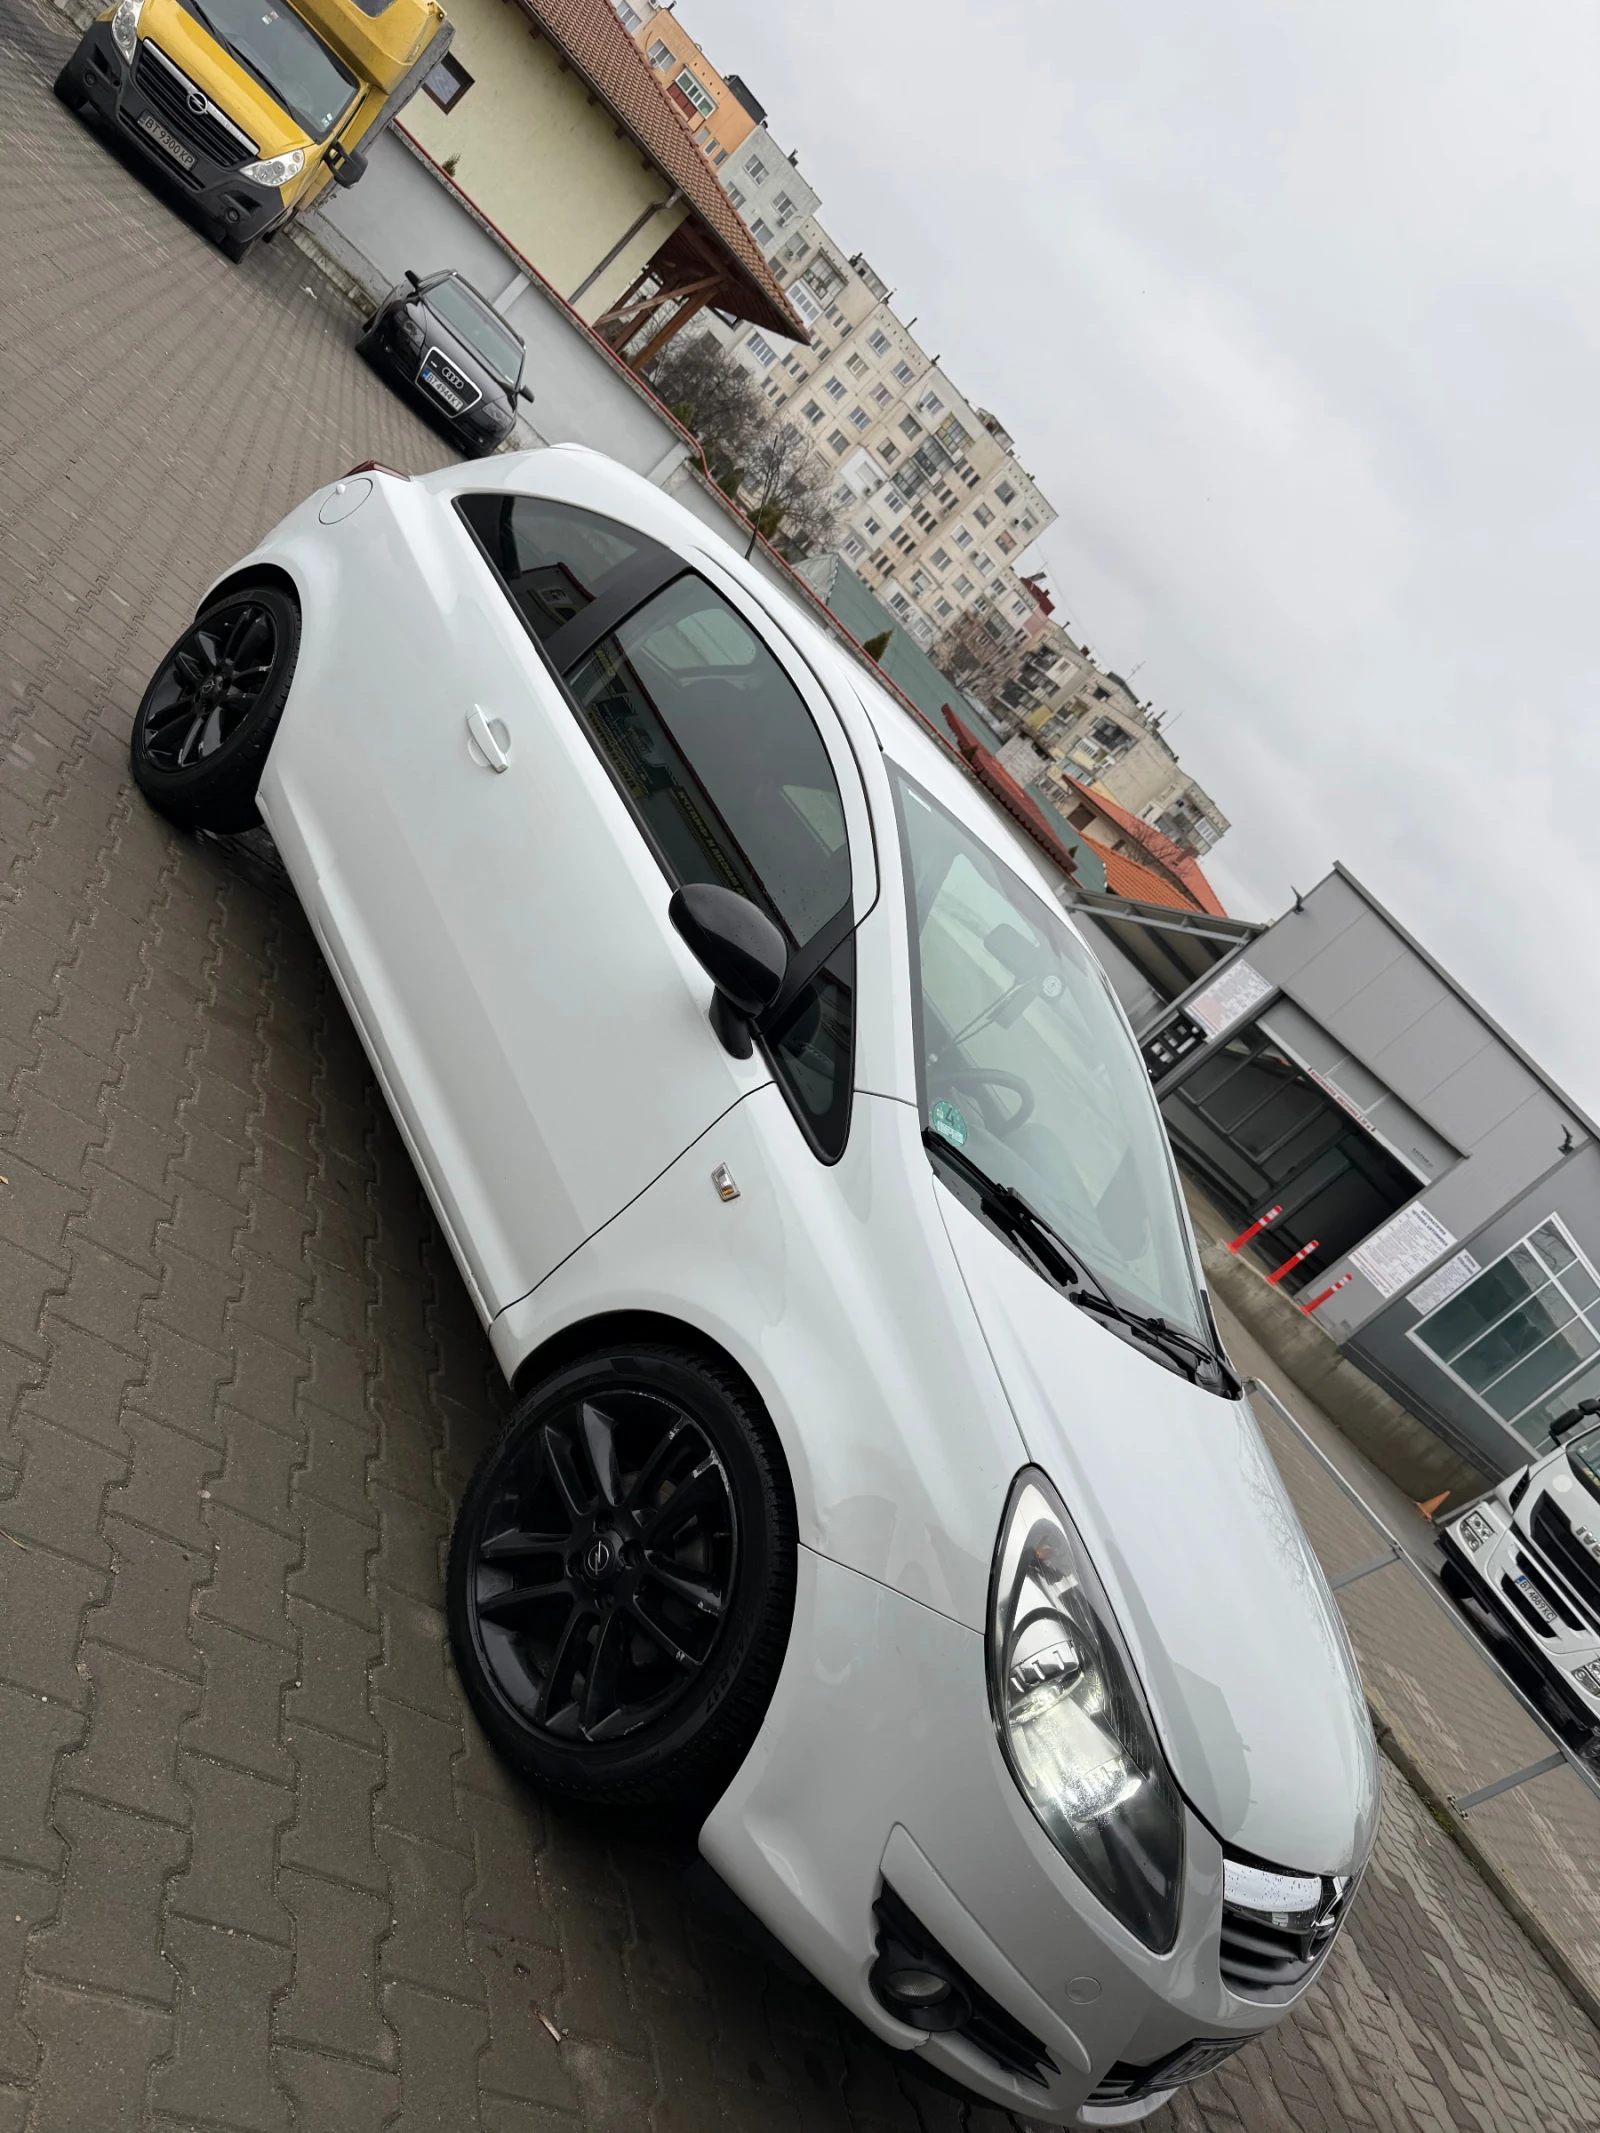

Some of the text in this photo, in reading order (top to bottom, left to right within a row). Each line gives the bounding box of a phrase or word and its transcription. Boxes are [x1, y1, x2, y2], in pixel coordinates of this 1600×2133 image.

[144, 117, 194, 164] BT 9300 KP
[426, 374, 461, 408] BT 4944 KT
[944, 1107, 954, 1126] 4
[1519, 1579, 1554, 1620] BT 4889 KC
